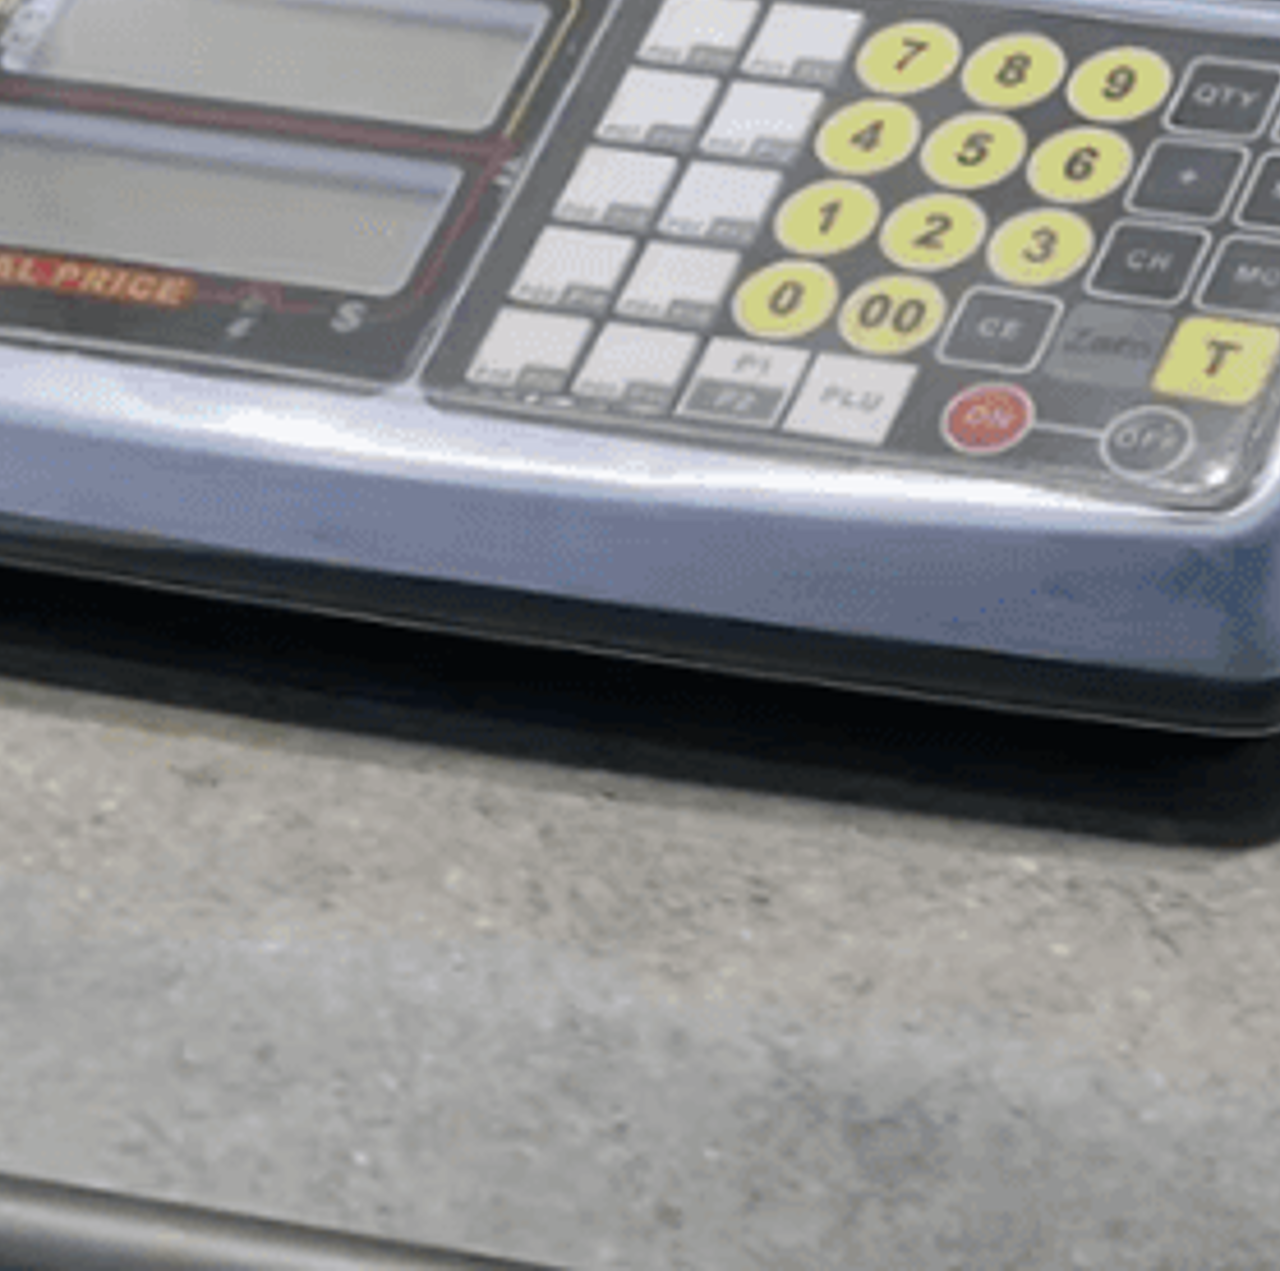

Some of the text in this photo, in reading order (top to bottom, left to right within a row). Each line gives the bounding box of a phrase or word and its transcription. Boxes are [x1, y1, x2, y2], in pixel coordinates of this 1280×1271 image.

[894, 36, 929, 75] 7
[994, 51, 1032, 88] 8
[1100, 64, 1138, 102] 9
[1192, 82, 1263, 108] QTY
[848, 119, 885, 153] 4
[954, 129, 995, 167] 5
[1062, 145, 1100, 183] 6
[818, 197, 843, 236] 1
[912, 211, 953, 250] 2
[1022, 225, 1060, 264] 3
[50, 264, 190, 306] PRICE
[769, 280, 806, 317] 0
[858, 293, 928, 334] 00
[1205, 337, 1243, 376] T
[820, 384, 887, 413] PLU
[965, 403, 1015, 429] ON
[1114, 421, 1178, 449] OFF
